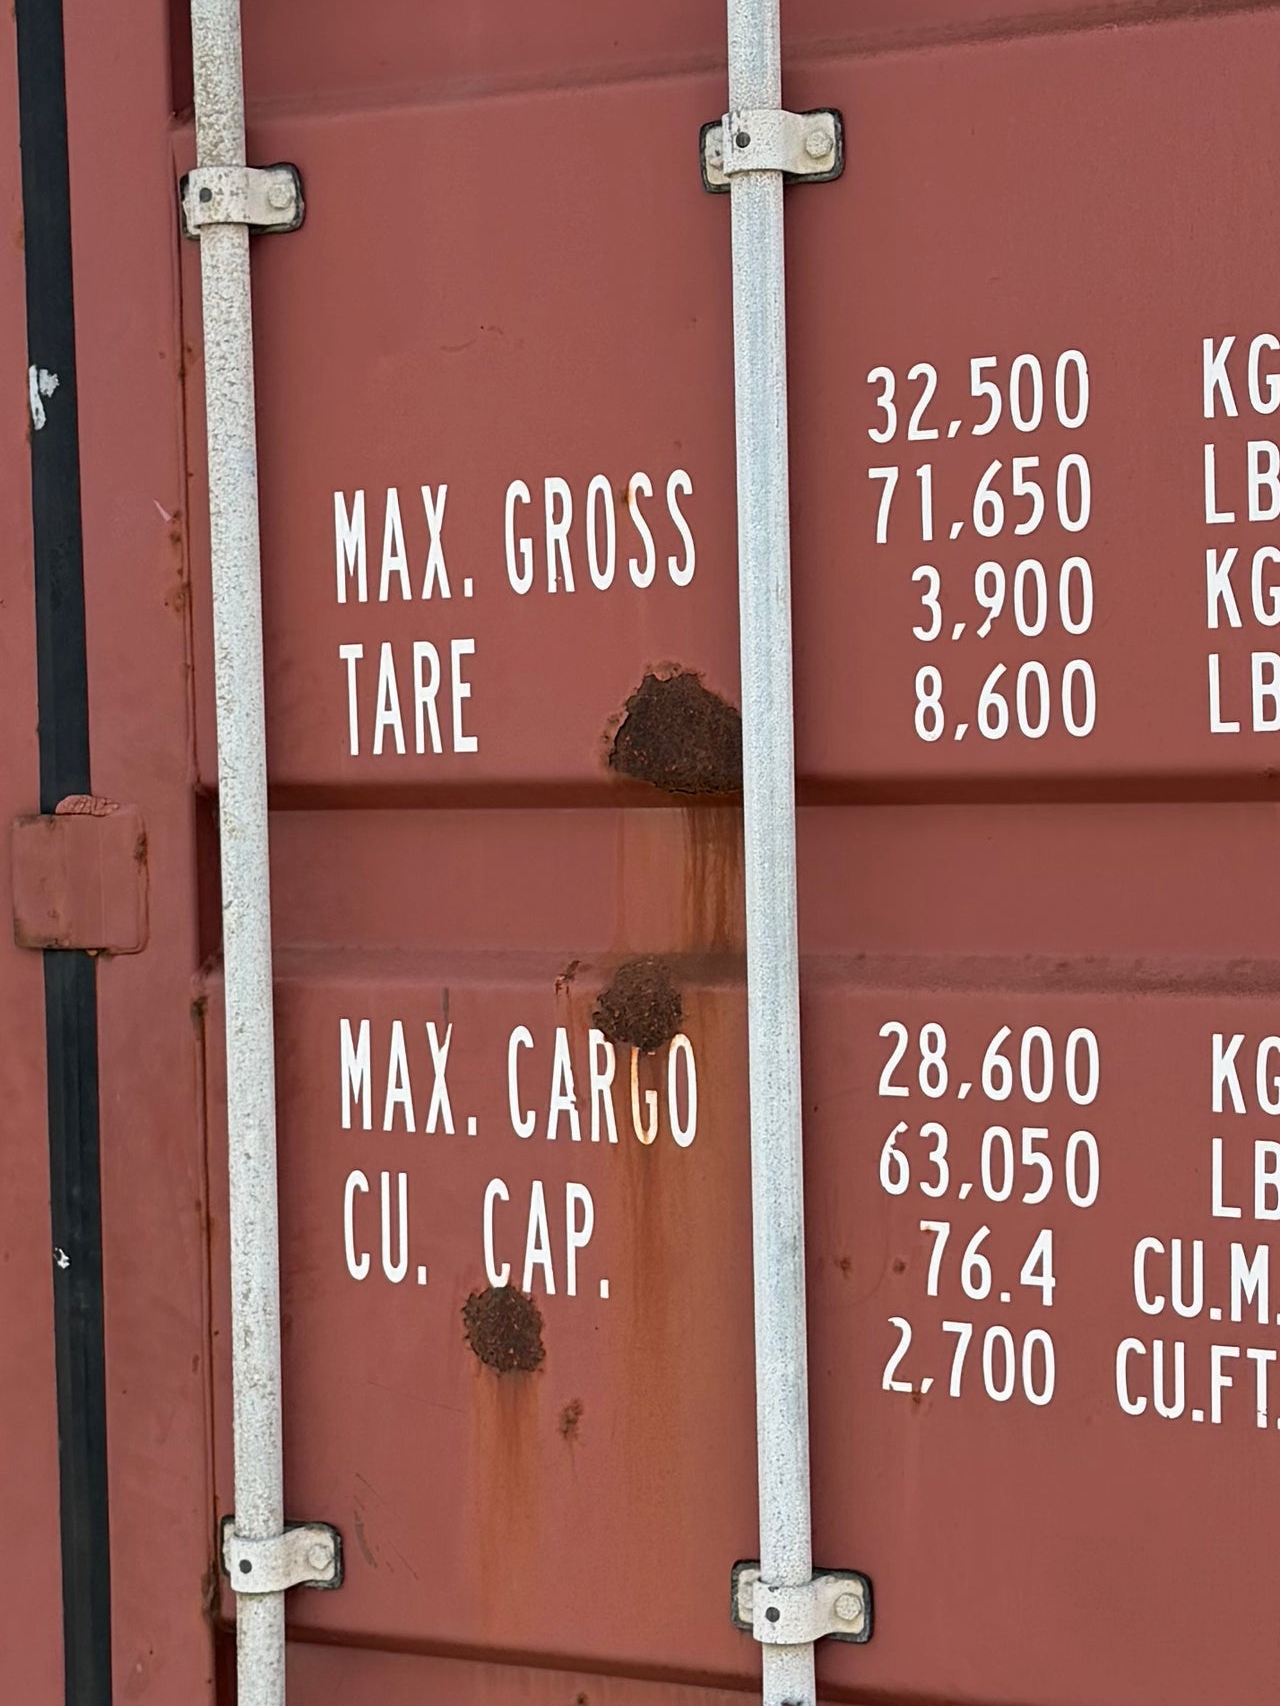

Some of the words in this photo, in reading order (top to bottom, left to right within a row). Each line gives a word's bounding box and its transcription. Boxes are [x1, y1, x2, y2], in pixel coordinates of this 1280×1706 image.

[868, 350, 1088, 443] 32,500
[1204, 334, 1280, 418] KG
[335, 485, 472, 603] MAX.
[505, 470, 695, 594] GROSS
[869, 454, 1090, 543] 71,650
[912, 557, 1093, 641] 3,900
[340, 639, 477, 755] TARE
[915, 660, 1095, 741] 8,600
[341, 1019, 476, 1135] MAX.
[508, 1026, 697, 1147] CARGO
[879, 1022, 1099, 1105] 28,600
[880, 1122, 1099, 1207] 63,050
[345, 1170, 426, 1284] CU.
[484, 1178, 608, 1298] CAP.
[920, 1221, 1055, 1306] 76.4
[883, 1317, 1054, 1405] 2,700
